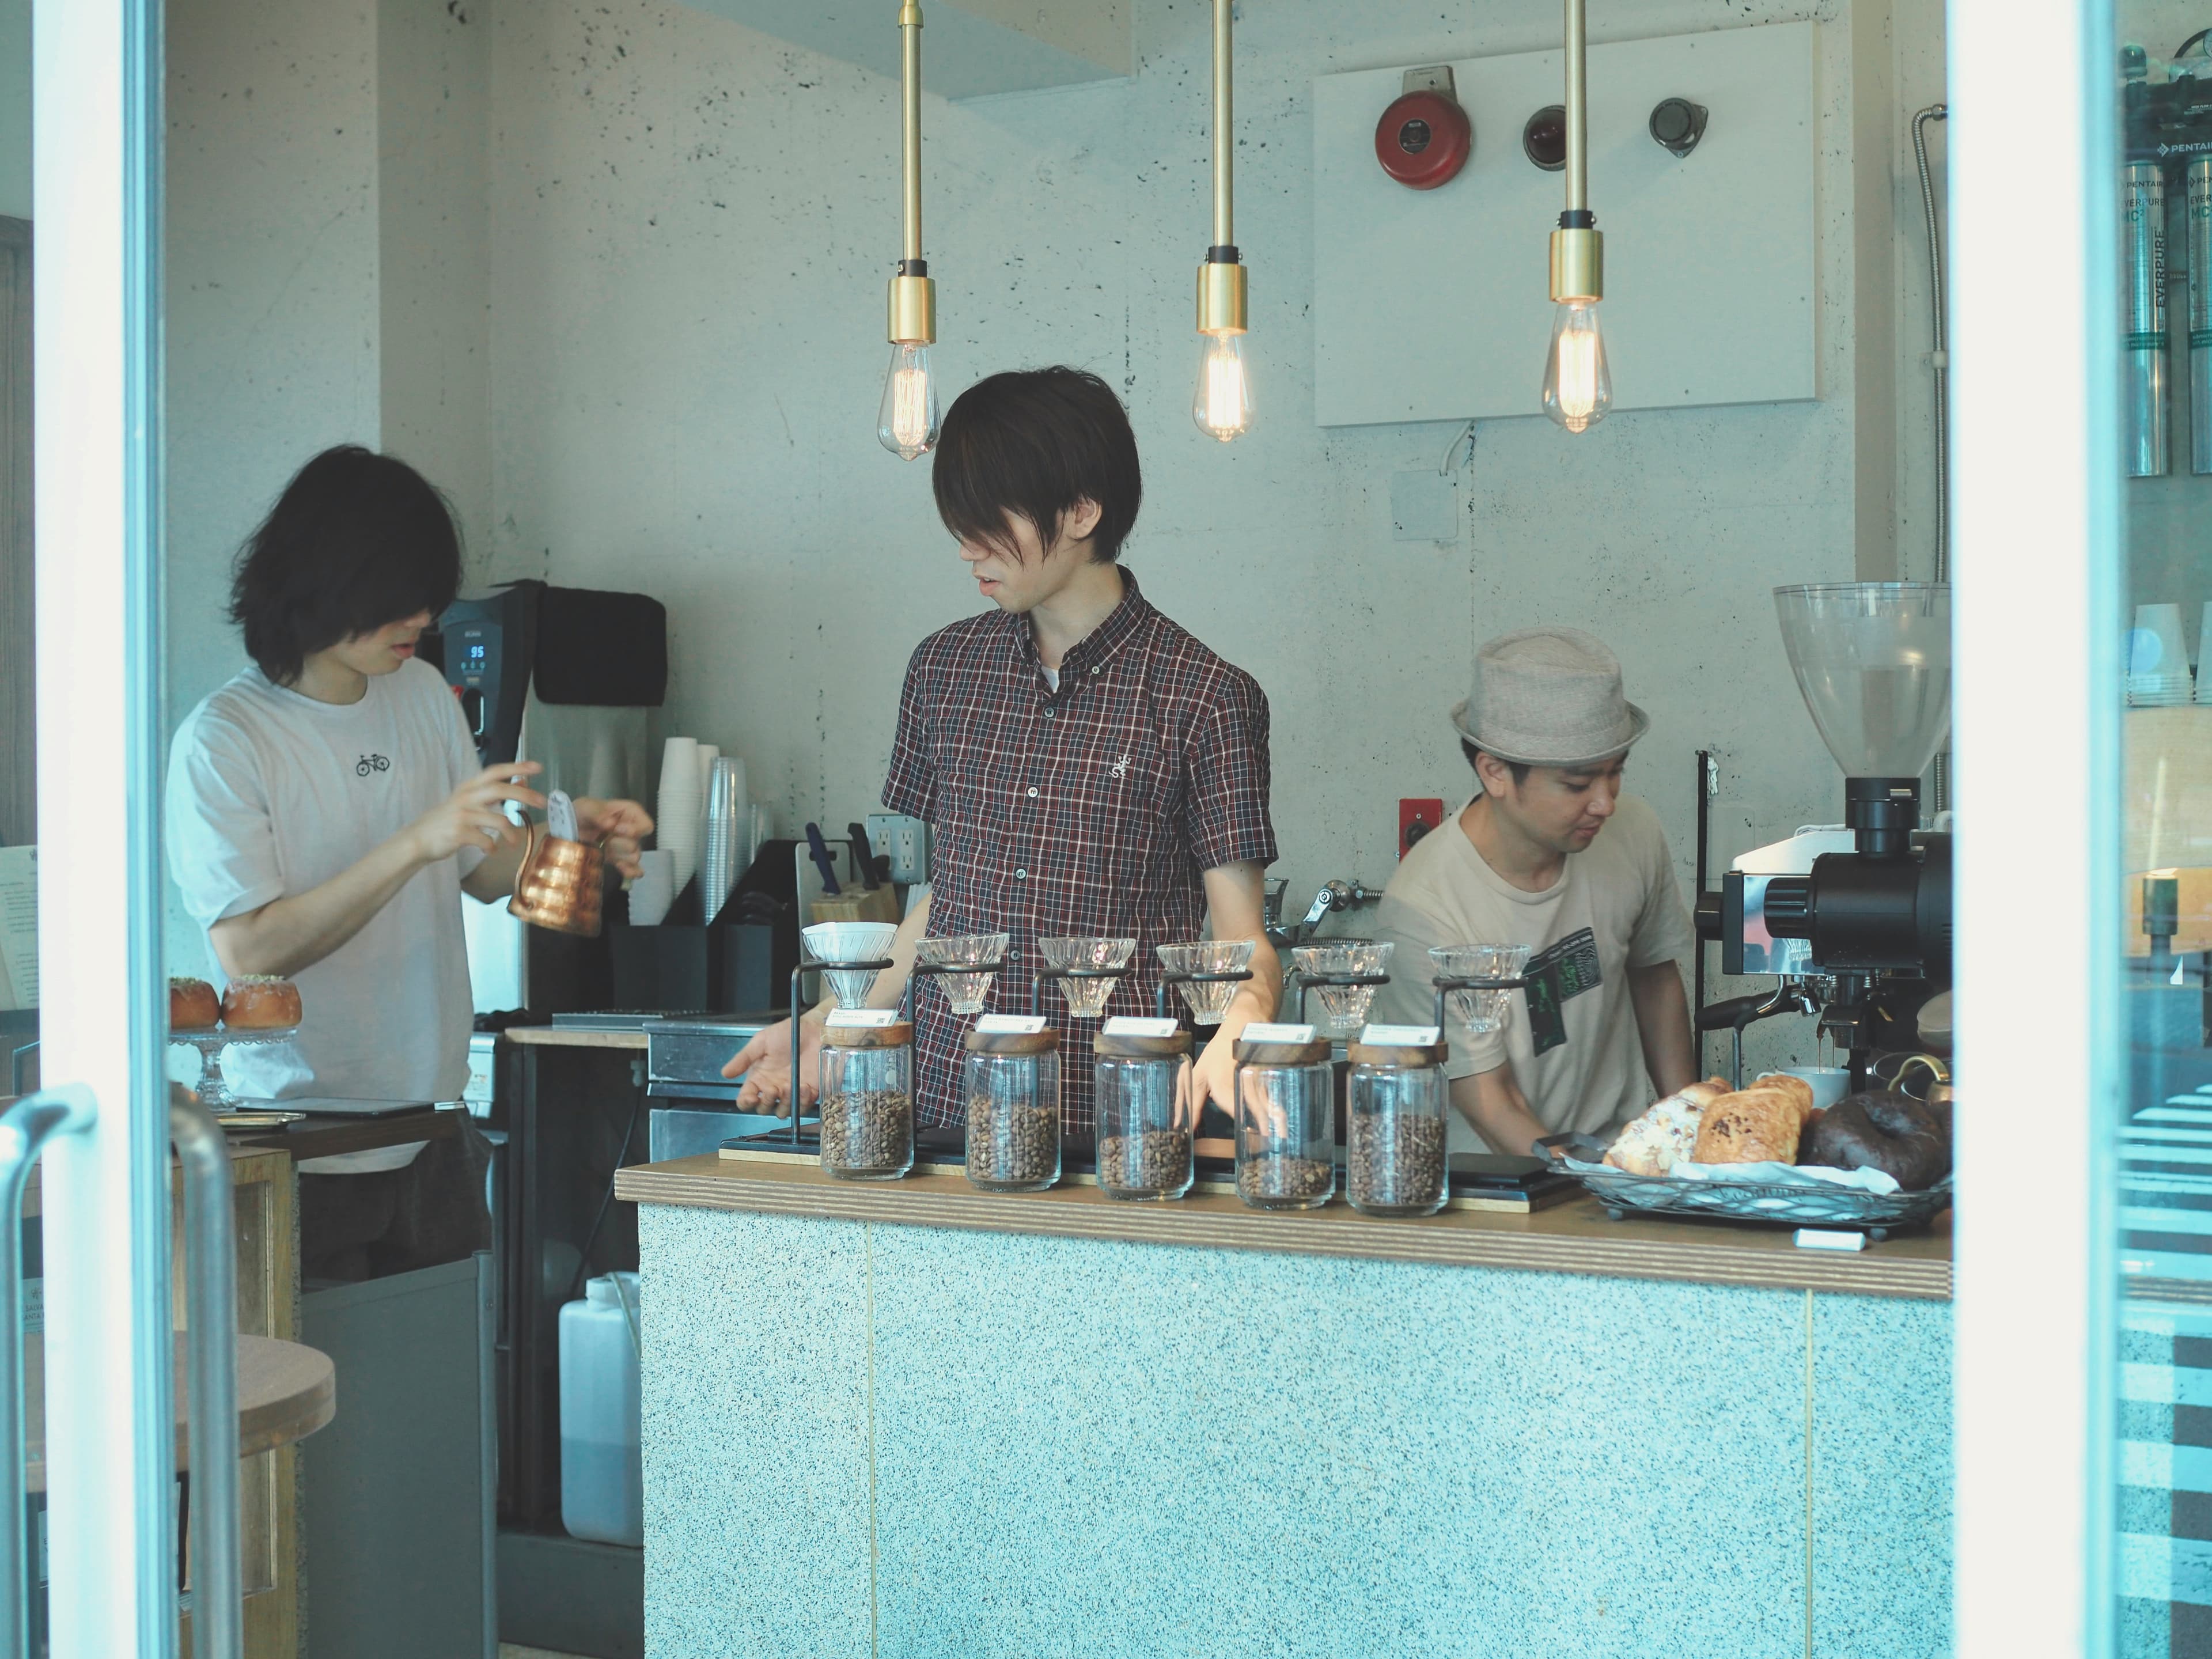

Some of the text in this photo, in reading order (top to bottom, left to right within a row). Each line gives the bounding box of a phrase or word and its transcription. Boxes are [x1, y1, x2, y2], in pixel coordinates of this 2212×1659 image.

[2171, 142, 2212, 153] PENTAI
[2124, 198, 2164, 207] VERPURE
[2155, 230, 2165, 308] EVERPURE
[471, 646, 484, 658] 95
